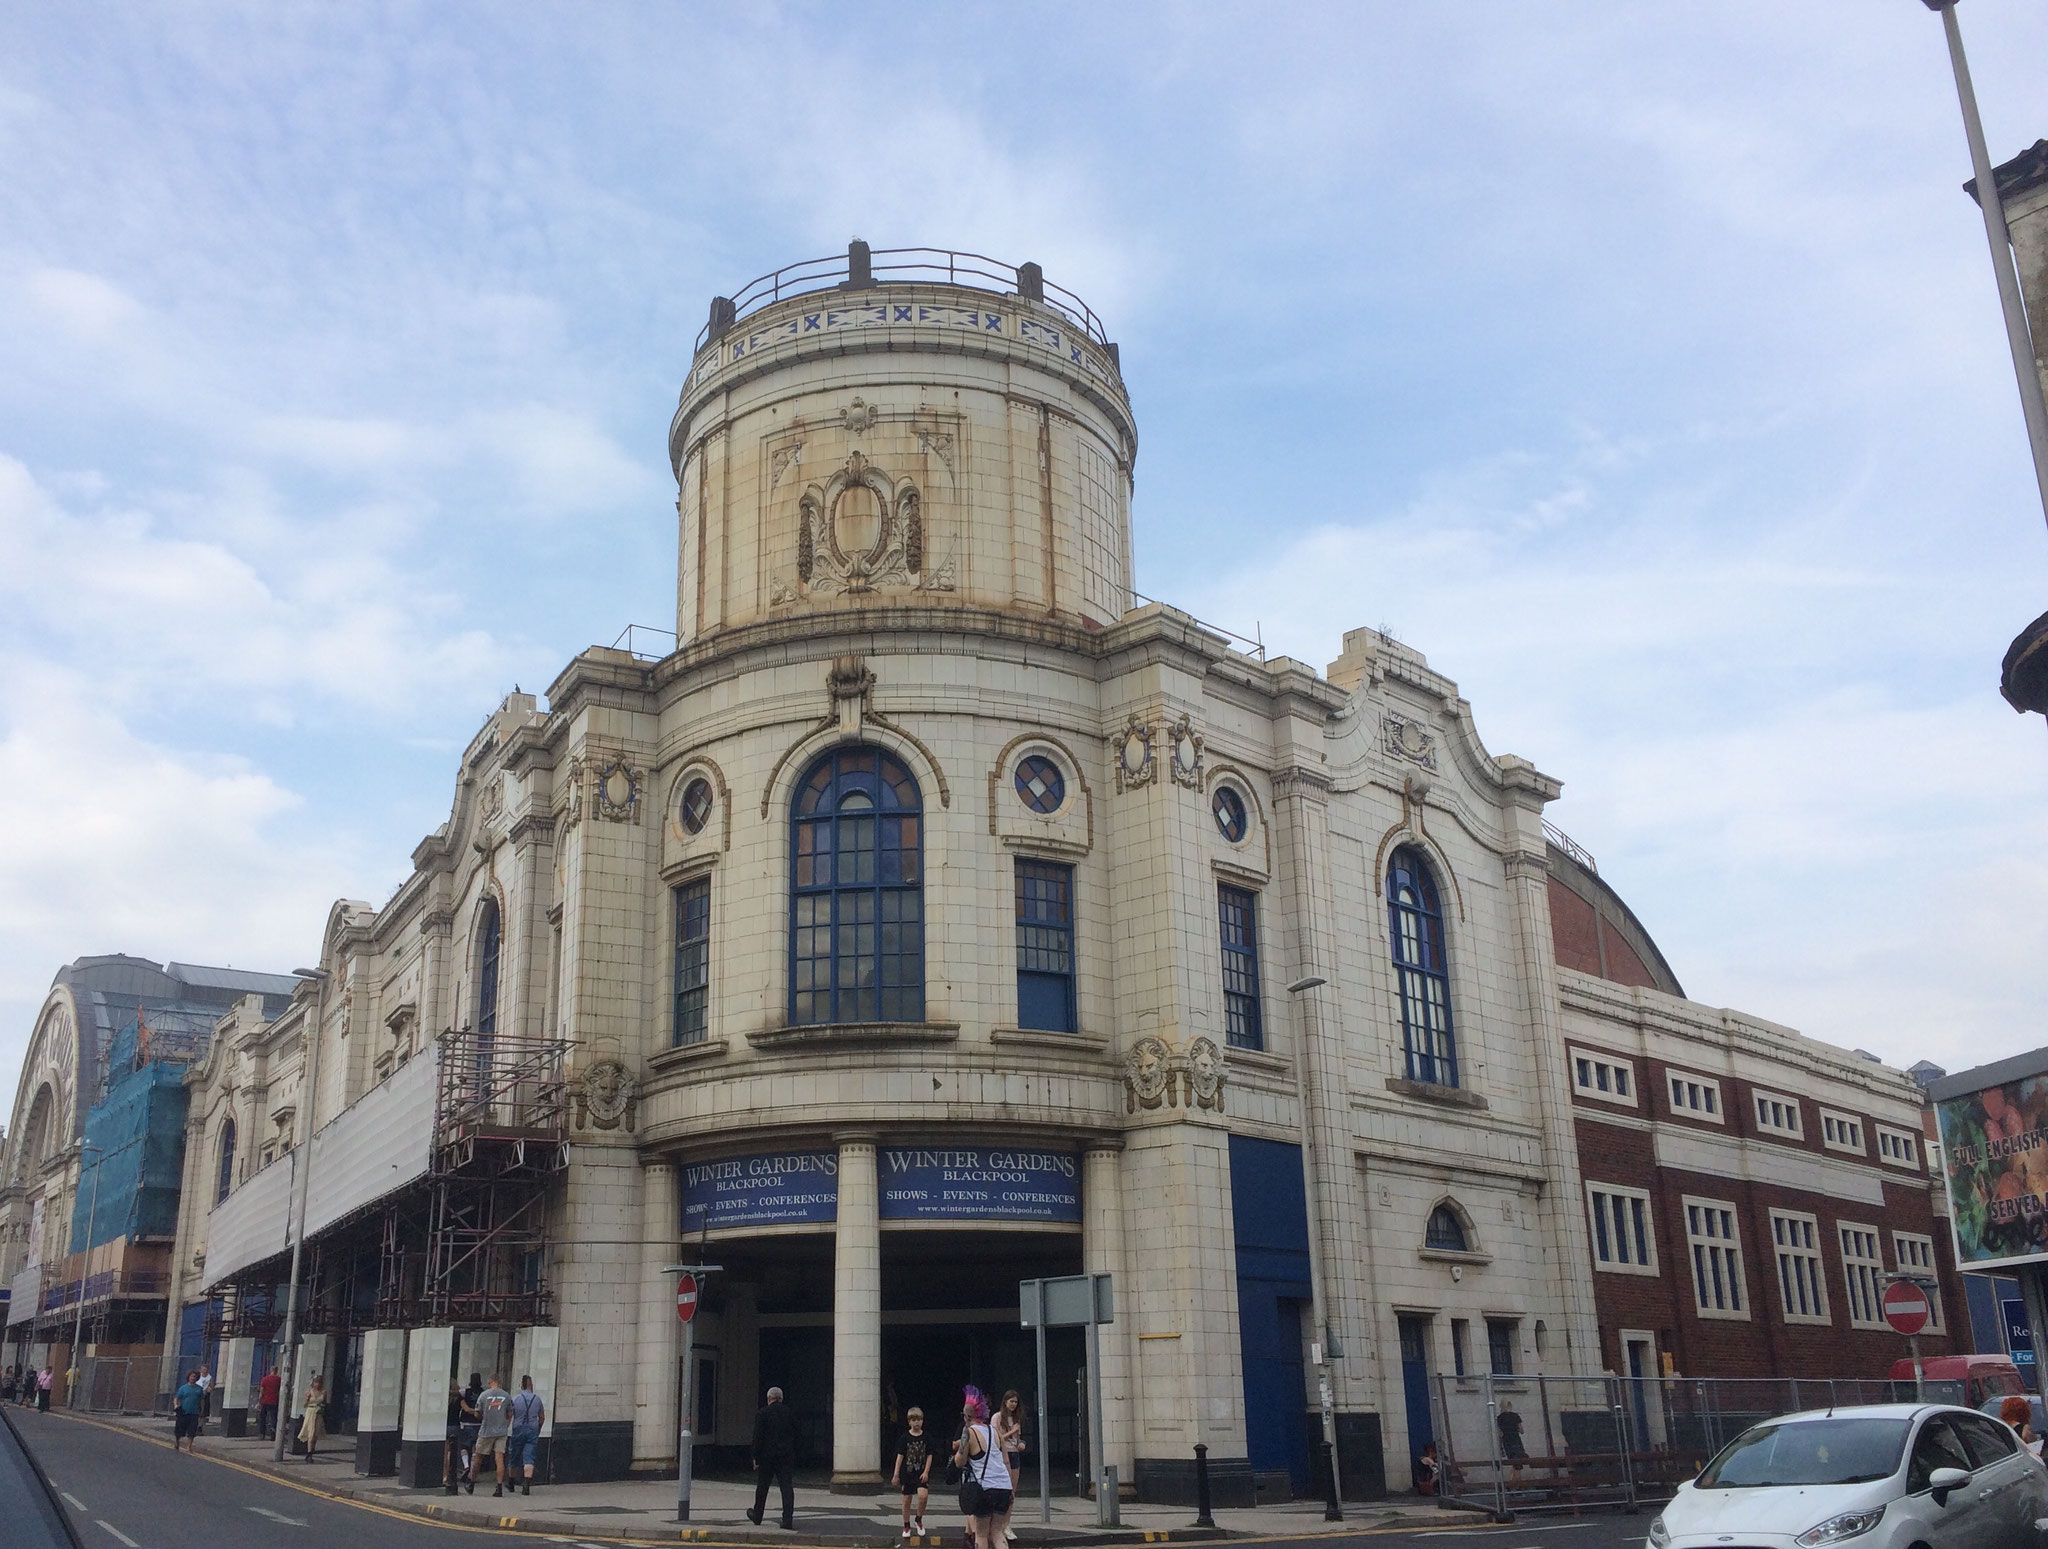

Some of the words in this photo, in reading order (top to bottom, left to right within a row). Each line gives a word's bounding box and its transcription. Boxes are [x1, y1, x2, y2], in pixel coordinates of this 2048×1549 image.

[1953, 1145, 1982, 1167] FULL
[1985, 1130, 2041, 1160] ENGLISH
[687, 1161, 742, 1188] WINTER
[749, 1154, 837, 1175] GARDENS
[887, 1151, 980, 1173] WINTER
[989, 1152, 1075, 1177] GARDENS
[716, 1176, 785, 1191] BLACKPOOL
[943, 1171, 1029, 1183] BLACKPOOL
[715, 1199, 748, 1211] EVENTS
[759, 1193, 837, 1206] CONFERENCES
[886, 1190, 928, 1200] SHOWS
[943, 1191, 988, 1201] EVENTS
[1002, 1192, 1076, 1204] CONFERENCES
[917, 1205, 1053, 1215] www.wintergardensblackpool.co.uk
[1991, 1194, 2041, 1220] SERVED
[702, 1209, 808, 1223] ww.wintergardensblackpool.co.uk
[2013, 1325, 2030, 1337] Re
[2016, 1353, 2033, 1361] For
